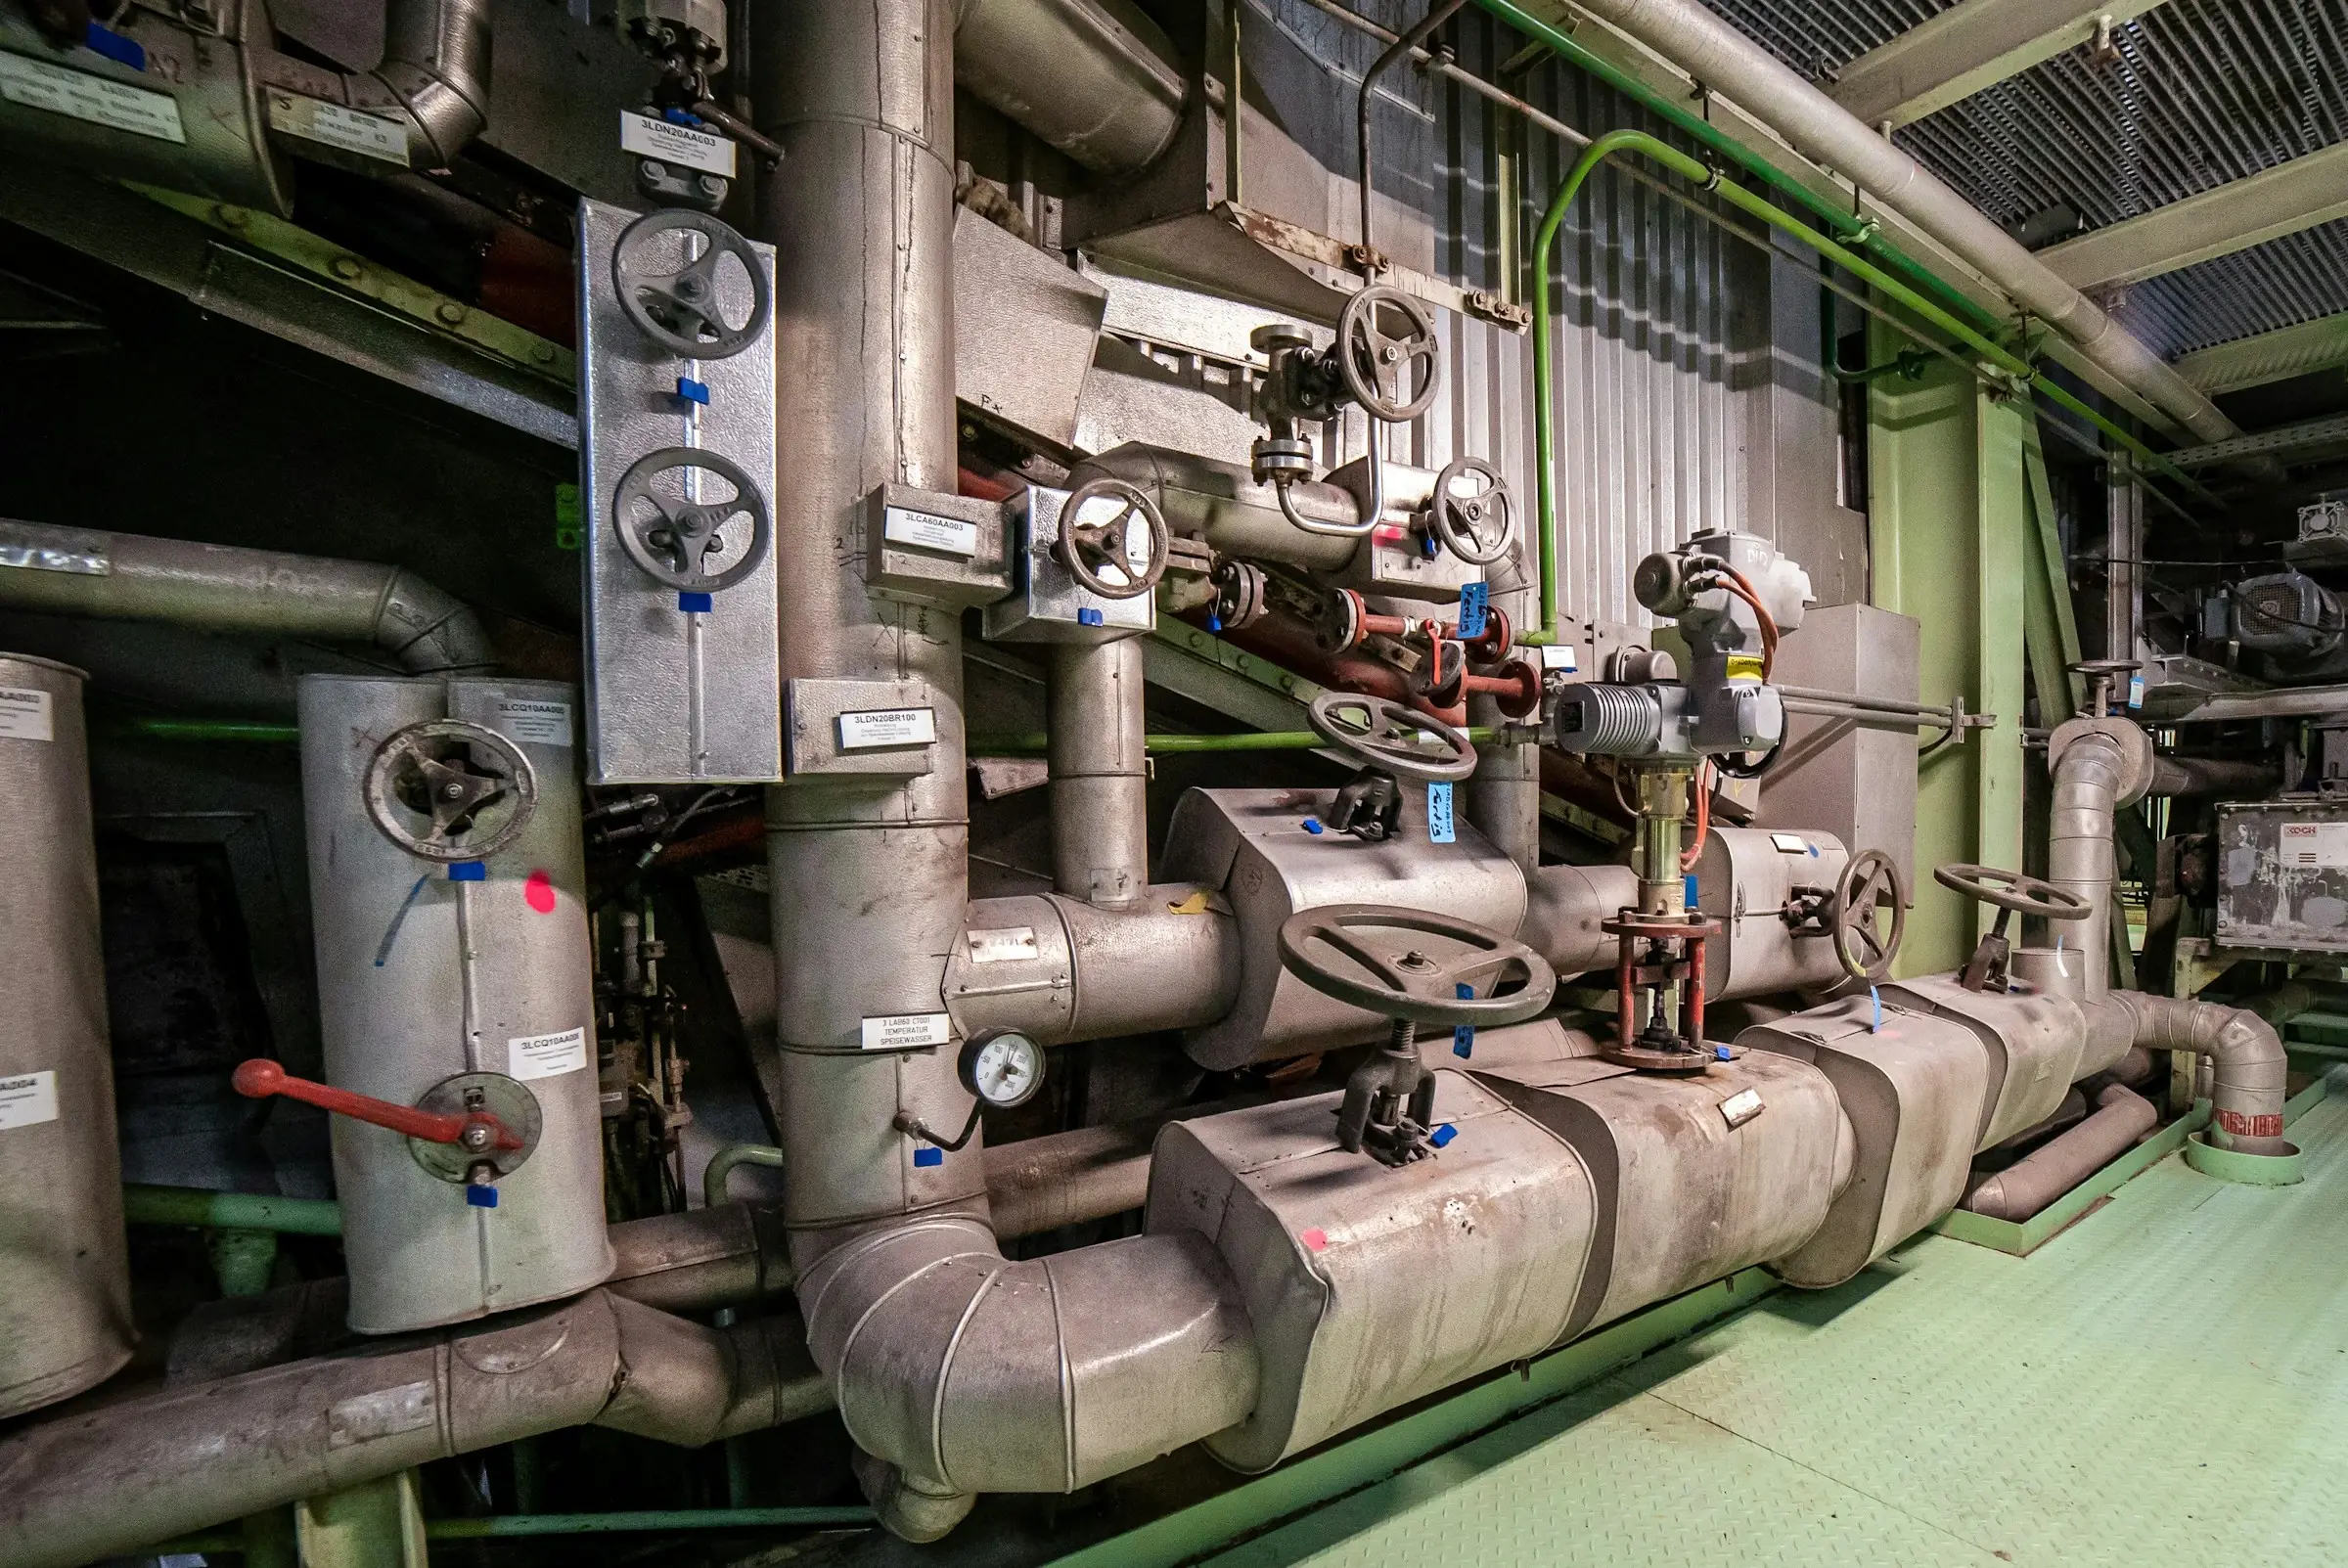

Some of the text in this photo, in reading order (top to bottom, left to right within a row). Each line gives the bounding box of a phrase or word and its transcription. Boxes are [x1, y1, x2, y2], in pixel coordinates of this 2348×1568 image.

[641, 118, 716, 147] 3LDN20AA003
[905, 513, 964, 531] 3LCA60AA003
[854, 713, 917, 724] 3LDN20BR100
[884, 1026, 928, 1036] TEMPERATUR
[880, 1035, 932, 1046] SPEISEWASSER
